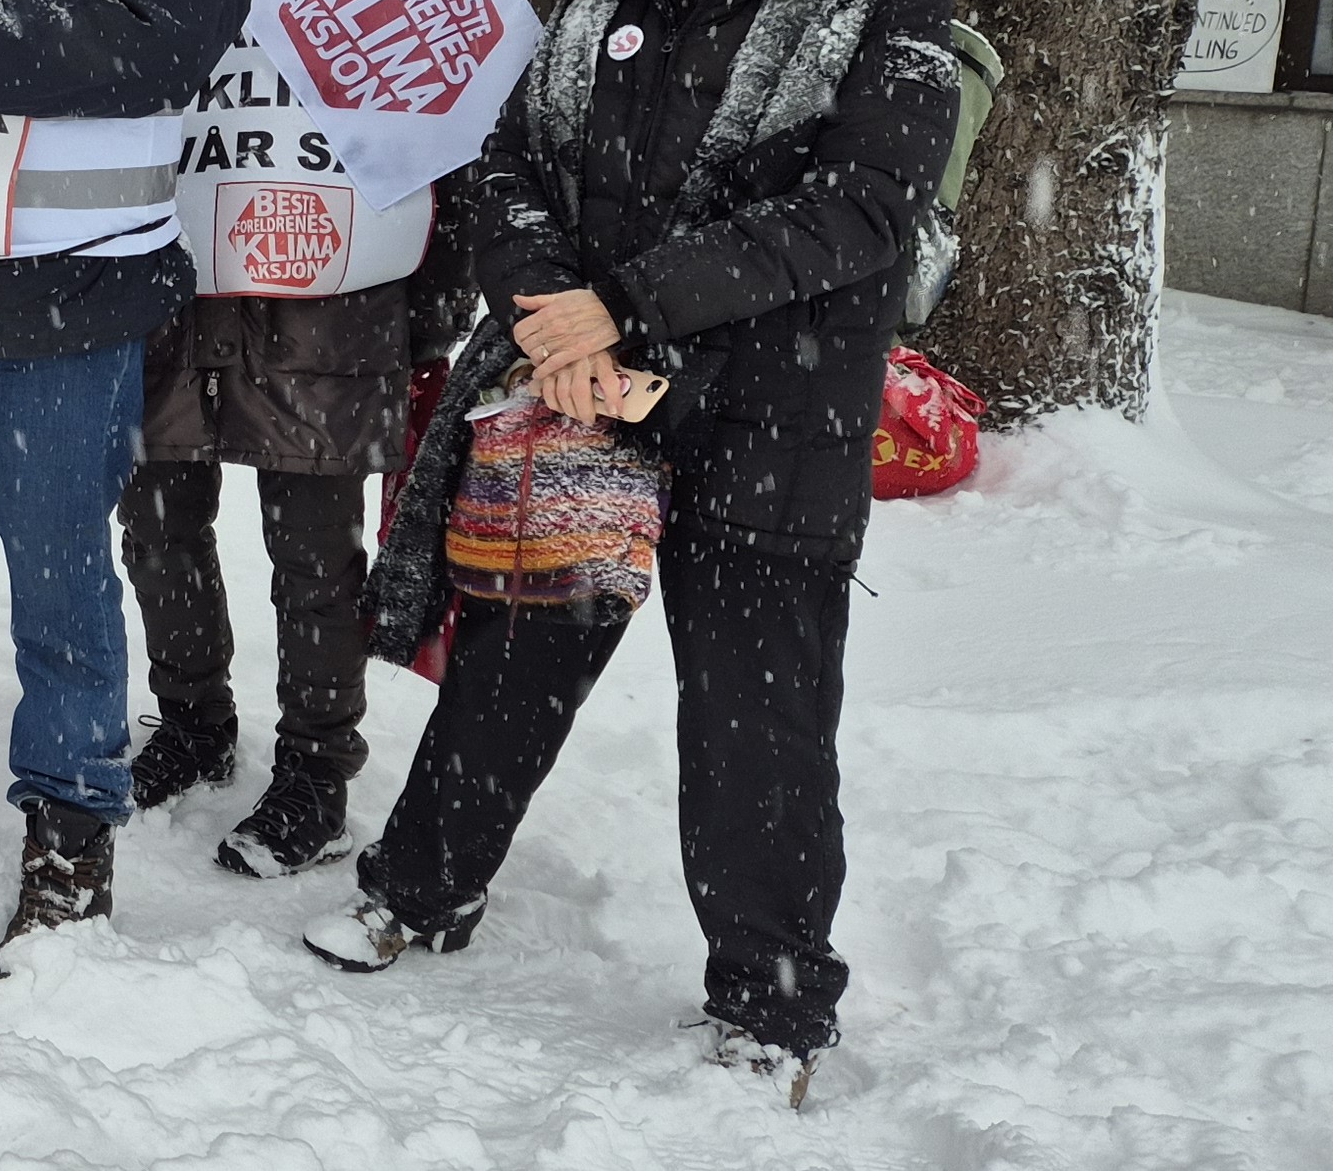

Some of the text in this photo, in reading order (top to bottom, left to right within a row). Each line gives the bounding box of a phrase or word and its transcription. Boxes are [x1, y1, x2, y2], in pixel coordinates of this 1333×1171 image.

[254, 191, 316, 217] BESTE
[234, 213, 333, 235] FORELDRENES
[235, 233, 334, 264] KLIMA
[247, 260, 324, 280] AKSJON
